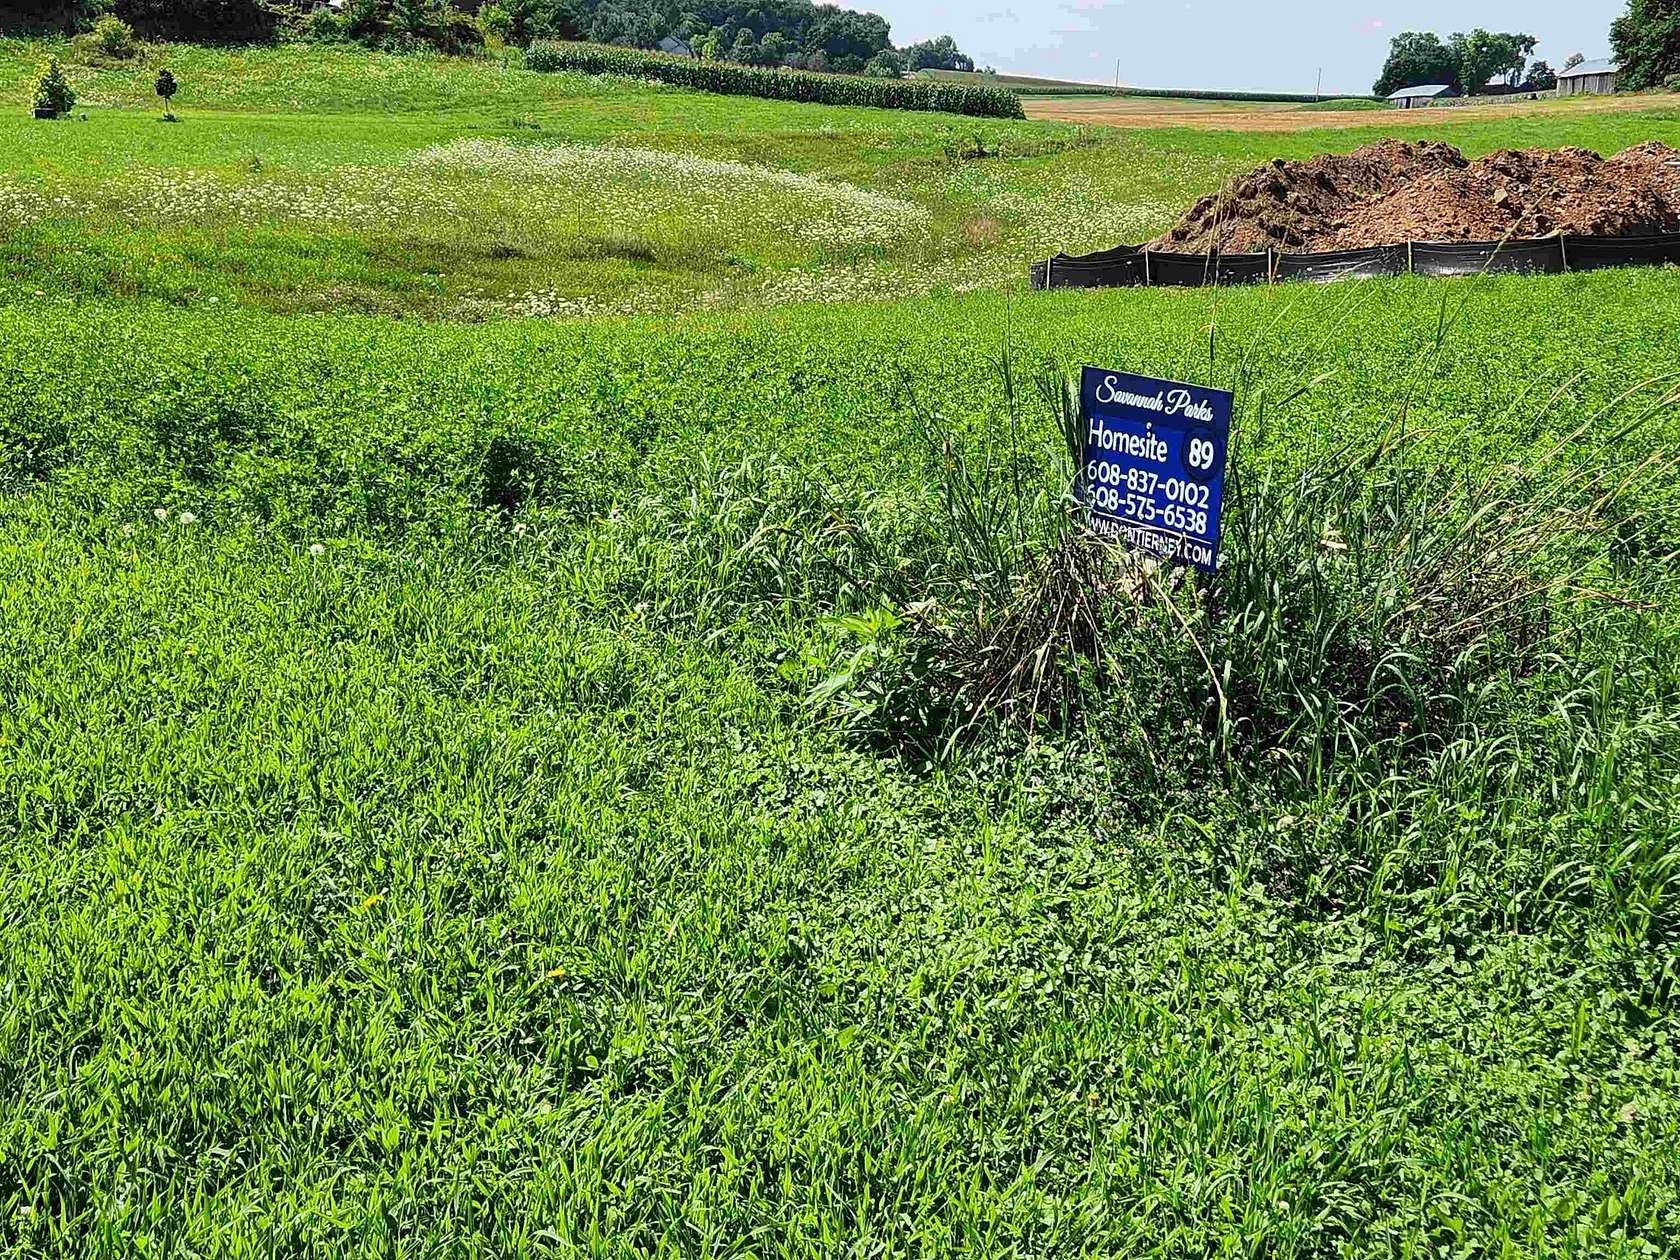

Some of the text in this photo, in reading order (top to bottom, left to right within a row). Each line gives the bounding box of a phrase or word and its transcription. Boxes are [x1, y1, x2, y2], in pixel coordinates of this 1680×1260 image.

[1095, 375, 1214, 422] Savannah Parks
[1088, 418, 1214, 470] Homesite 89
[1086, 484, 1208, 535] 608-575-6538
[1087, 459, 1210, 510] 608-837-0102
